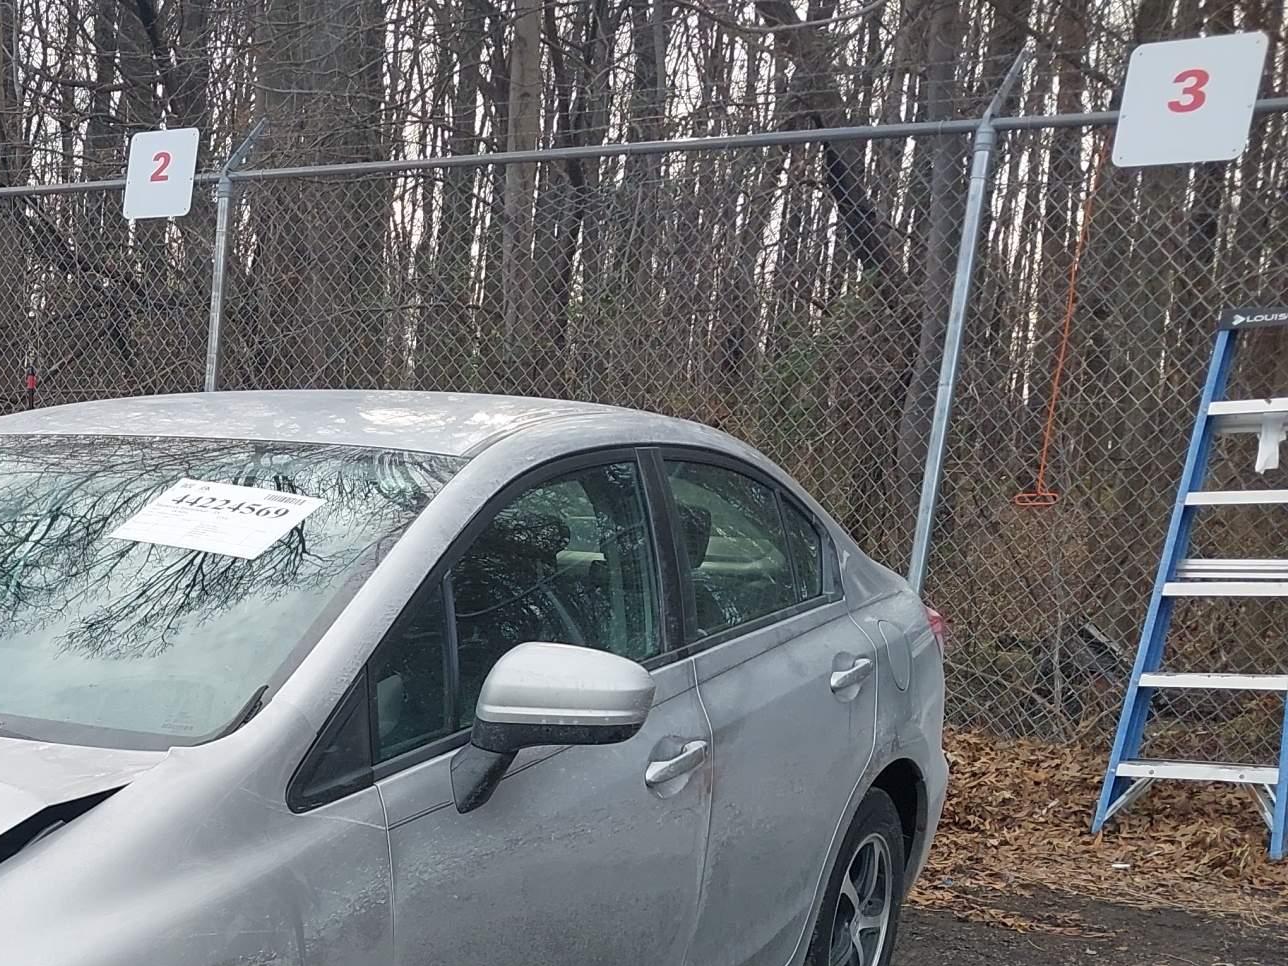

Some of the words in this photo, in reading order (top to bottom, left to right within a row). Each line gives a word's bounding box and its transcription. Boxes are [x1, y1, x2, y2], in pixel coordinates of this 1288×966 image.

[1167, 69, 1210, 113] 3
[150, 151, 171, 182] 2
[1246, 312, 1288, 323] LOUIS
[171, 493, 290, 519] 44224569
